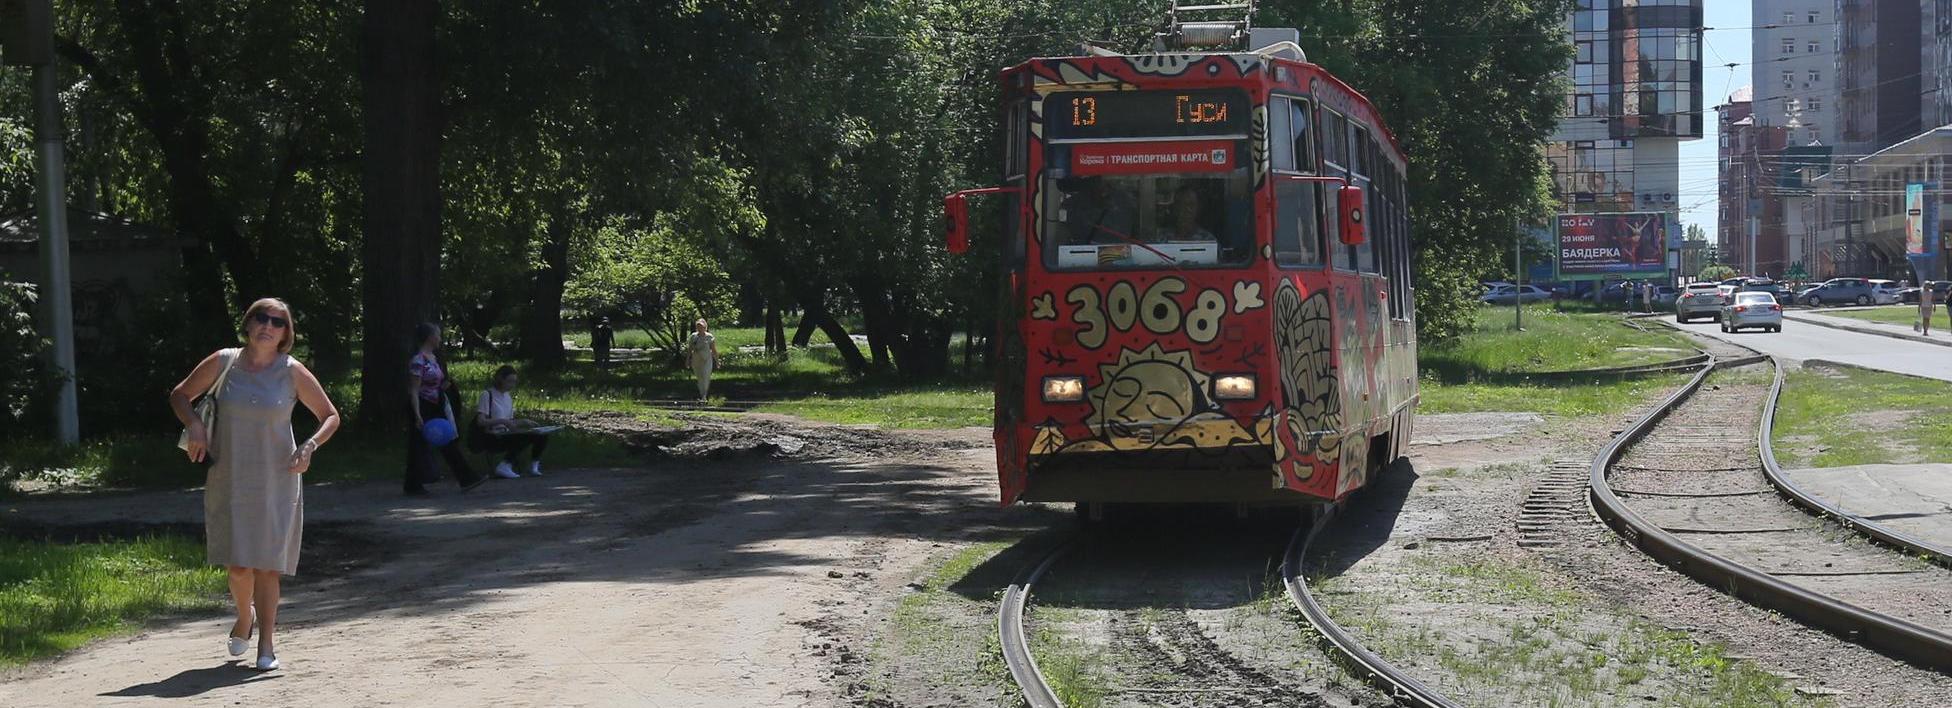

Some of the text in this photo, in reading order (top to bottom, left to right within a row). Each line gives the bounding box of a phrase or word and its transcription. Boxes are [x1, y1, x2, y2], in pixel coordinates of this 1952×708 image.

[1072, 95, 1226, 126] 13 Гуси
[1111, 153, 1209, 164] ТРАНСПОРТНАЯ КАРТА
[1562, 248, 1620, 259] БАЯДЕРКА
[1066, 276, 1226, 350] 3068
